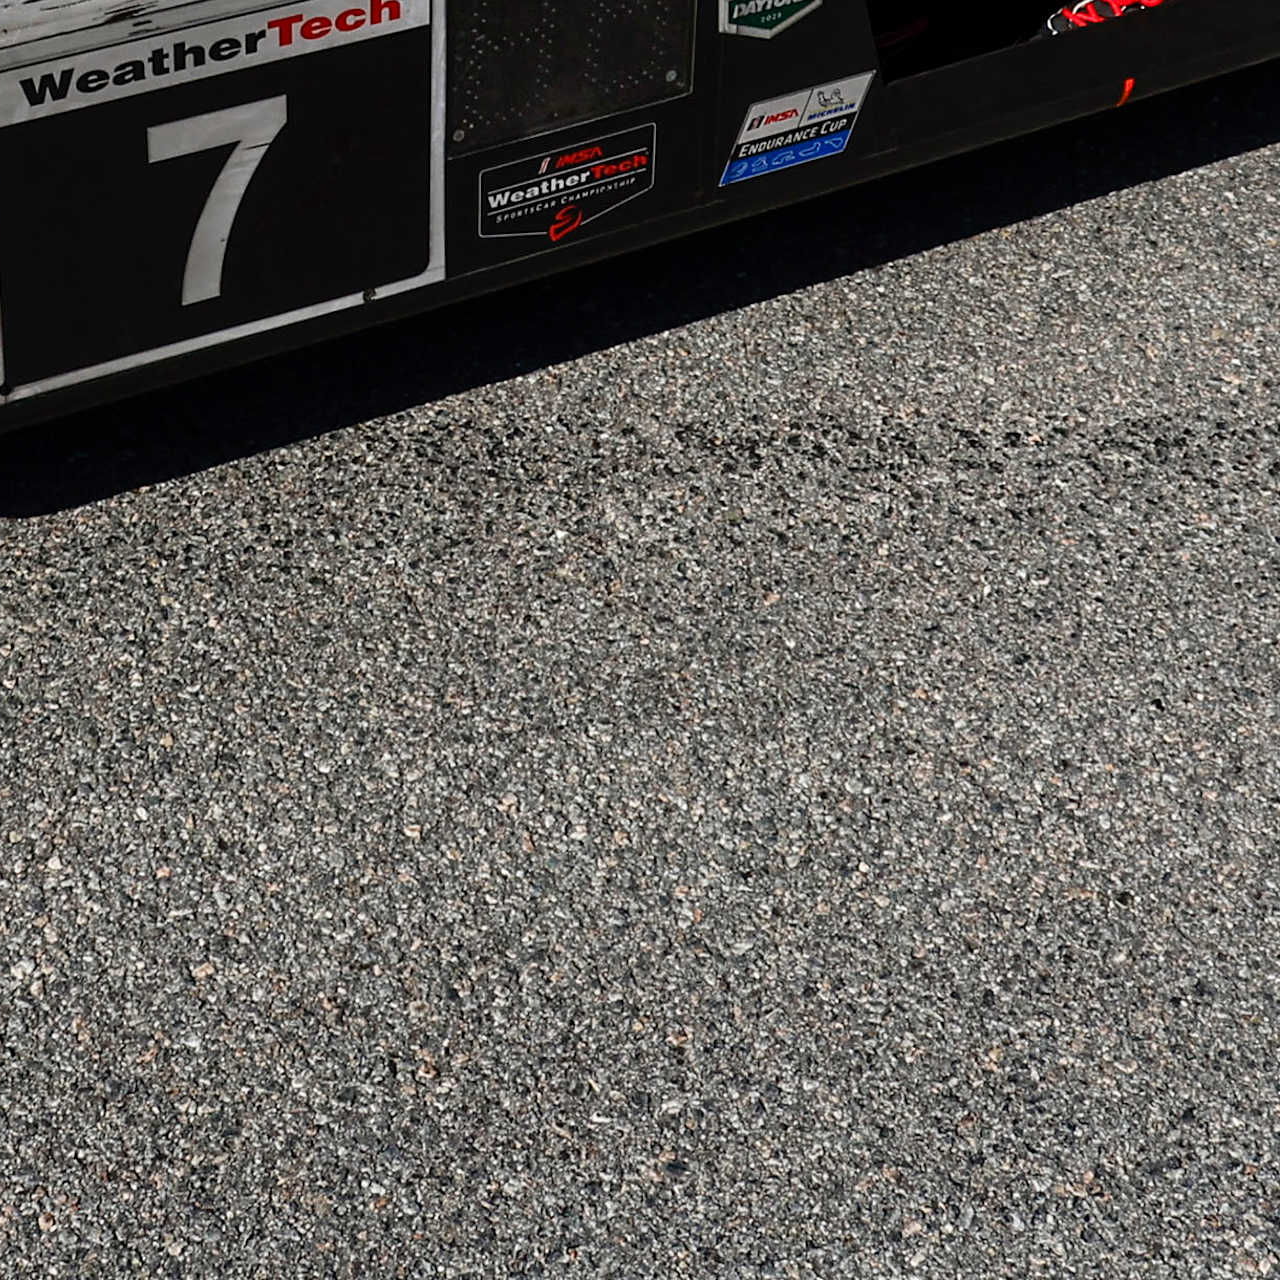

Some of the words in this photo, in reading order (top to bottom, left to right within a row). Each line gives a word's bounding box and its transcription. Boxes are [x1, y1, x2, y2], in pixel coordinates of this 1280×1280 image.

[764, 108, 799, 126] IMSA
[554, 146, 603, 169] IMSA
[737, 125, 817, 159] ENDURANCE
[819, 118, 848, 136] CUP
[146, 93, 288, 306] 7
[487, 153, 649, 209] WeatherTech
